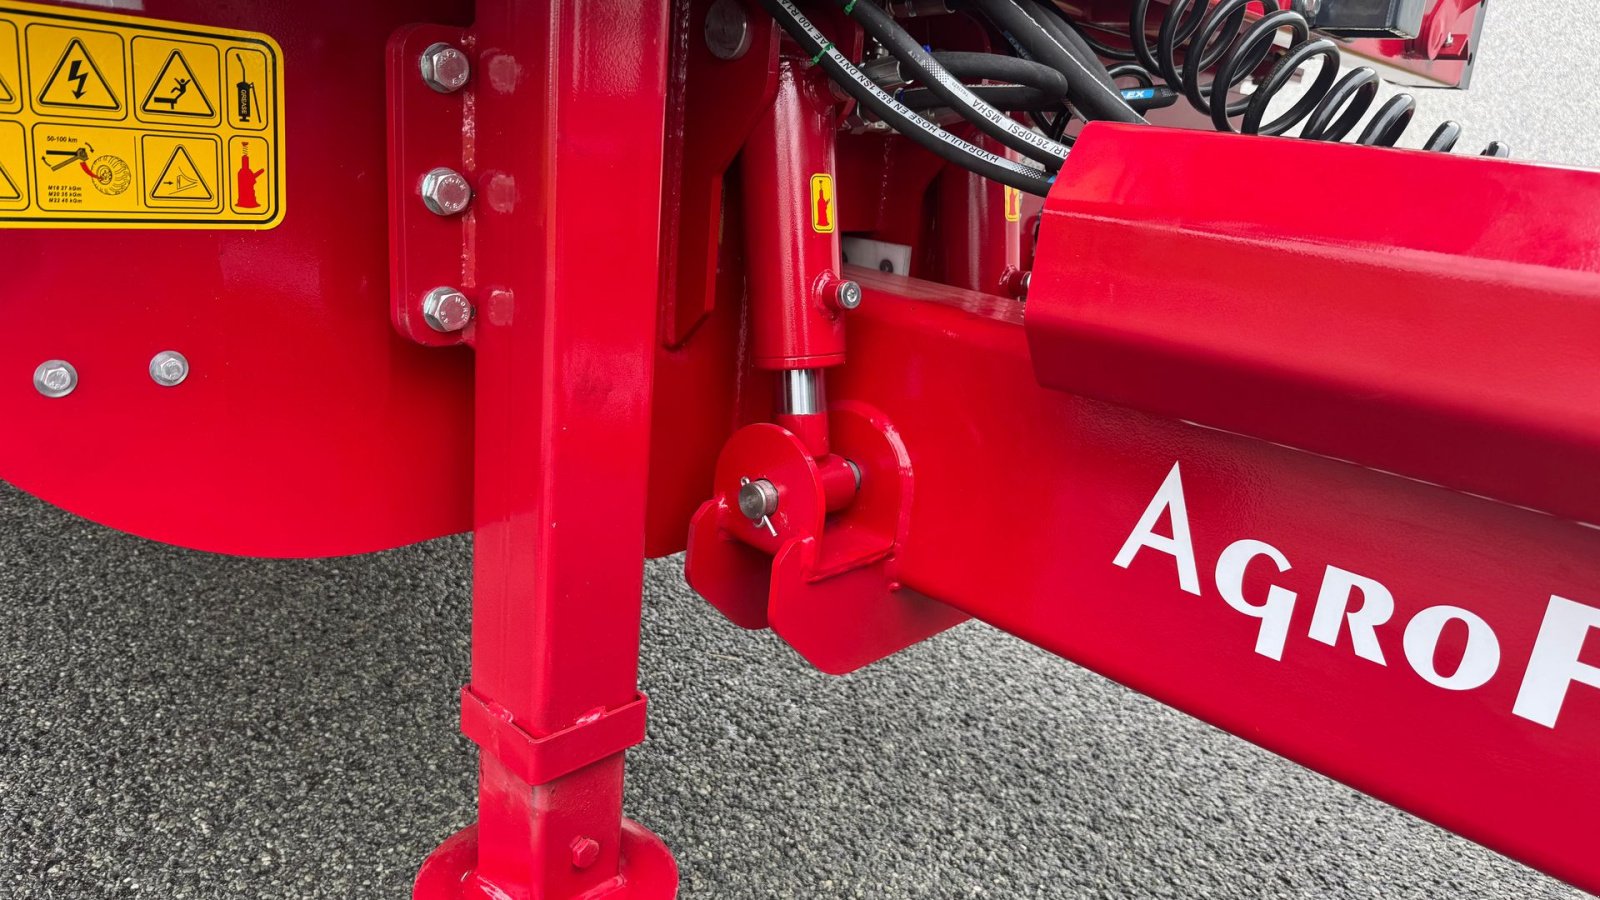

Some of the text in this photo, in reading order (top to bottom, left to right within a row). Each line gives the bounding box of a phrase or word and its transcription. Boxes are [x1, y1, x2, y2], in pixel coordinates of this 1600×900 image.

[799, 16, 814, 32] 100
[835, 53, 858, 76] DN10
[857, 75, 876, 91] 1SN
[876, 90, 894, 104] 853
[893, 103, 908, 115] EN
[972, 99, 1002, 124] MSHA
[909, 113, 938, 134] HOSE
[1007, 123, 1049, 149] 2610PSI
[938, 131, 999, 164] HYDRAULIC
